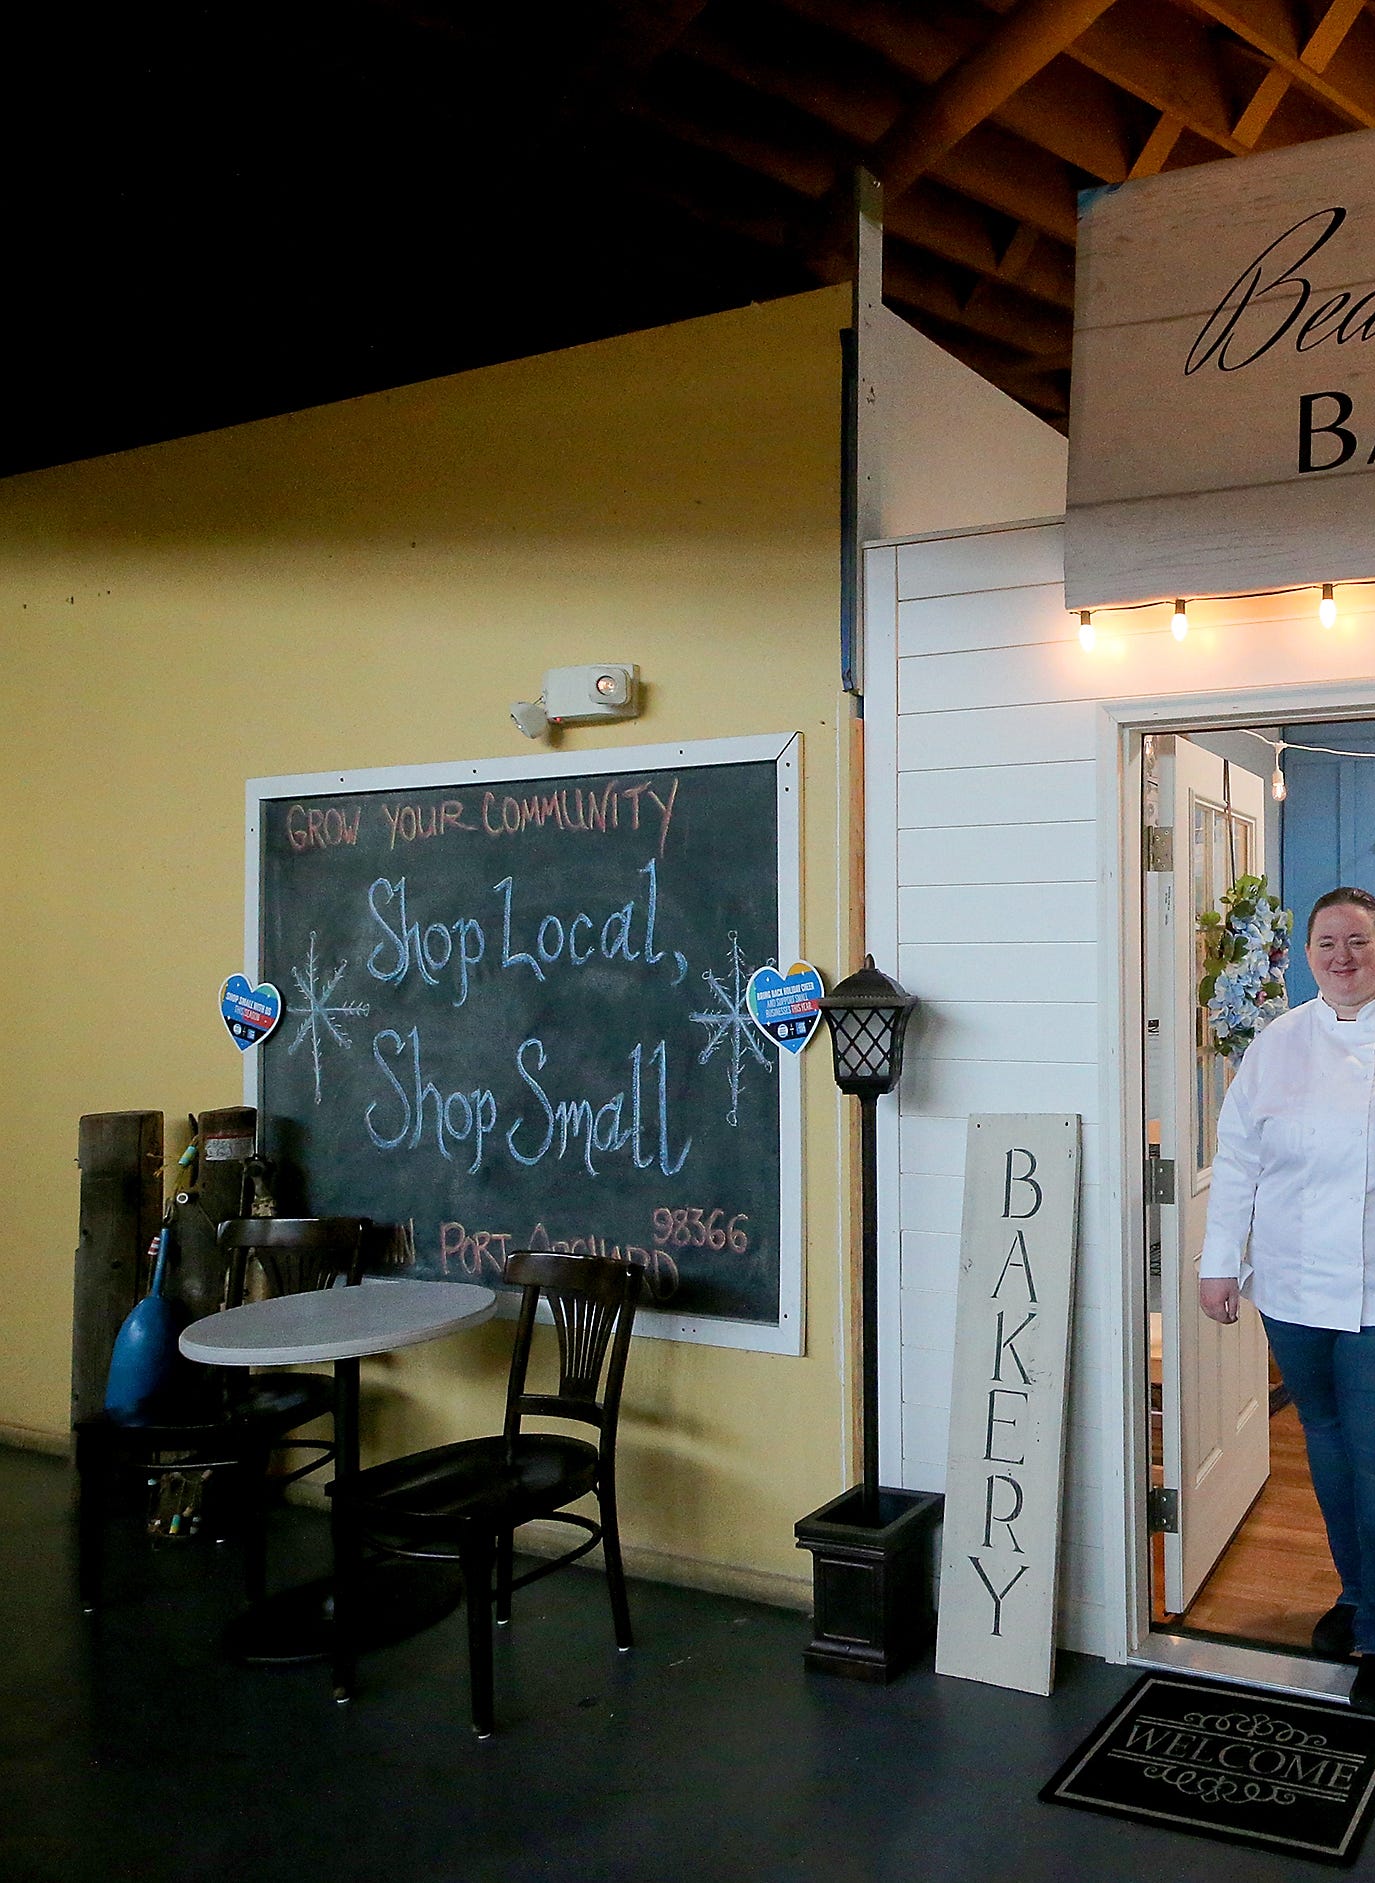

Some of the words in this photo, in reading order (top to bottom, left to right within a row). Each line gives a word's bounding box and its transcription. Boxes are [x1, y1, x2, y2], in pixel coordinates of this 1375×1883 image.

[286, 804, 361, 850] GROW
[382, 800, 479, 851] YOUR
[482, 777, 679, 857] COMMUNITY
[366, 875, 485, 1007] Shop
[493, 857, 688, 986] Local,
[365, 1025, 497, 1175] Shop
[506, 1038, 692, 1176] Small
[440, 1221, 512, 1276] PORT
[652, 1206, 749, 1254] 98366
[968, 1148, 1043, 1637] BAKERY
[1124, 1725, 1360, 1791] WELCOME
